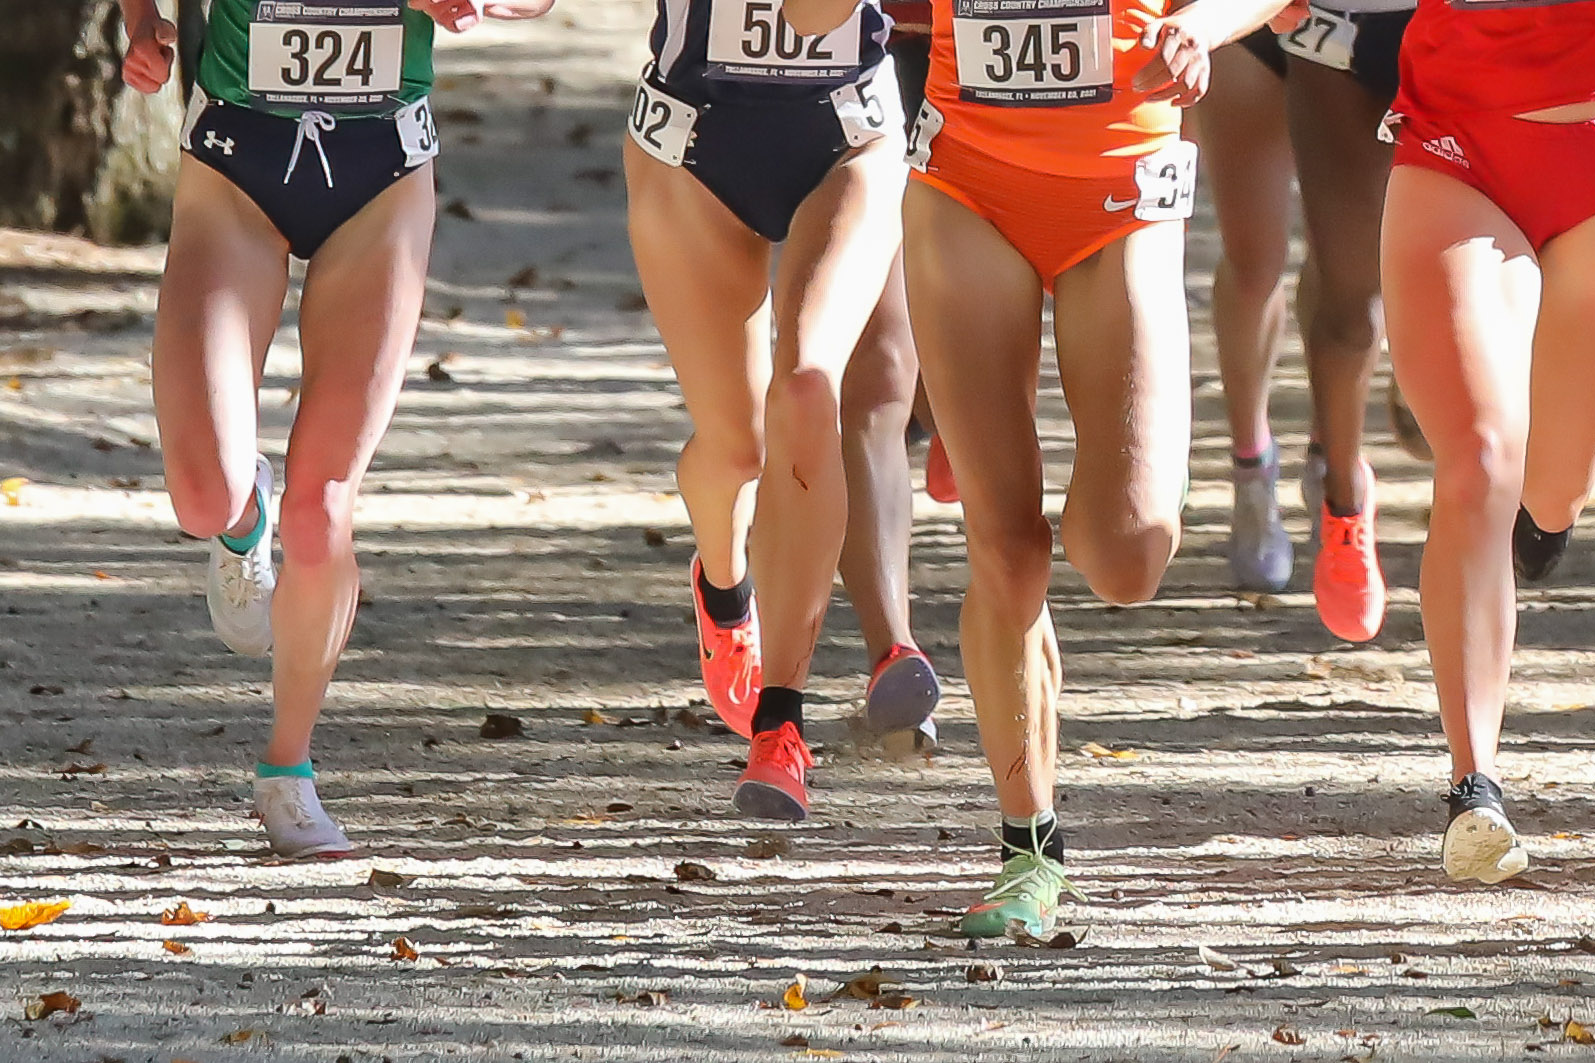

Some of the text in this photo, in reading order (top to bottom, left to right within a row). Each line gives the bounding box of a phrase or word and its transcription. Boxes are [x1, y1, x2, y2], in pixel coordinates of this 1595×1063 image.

[281, 29, 374, 86] 324
[983, 23, 1081, 83] 345
[1421, 141, 1471, 169] adidas
